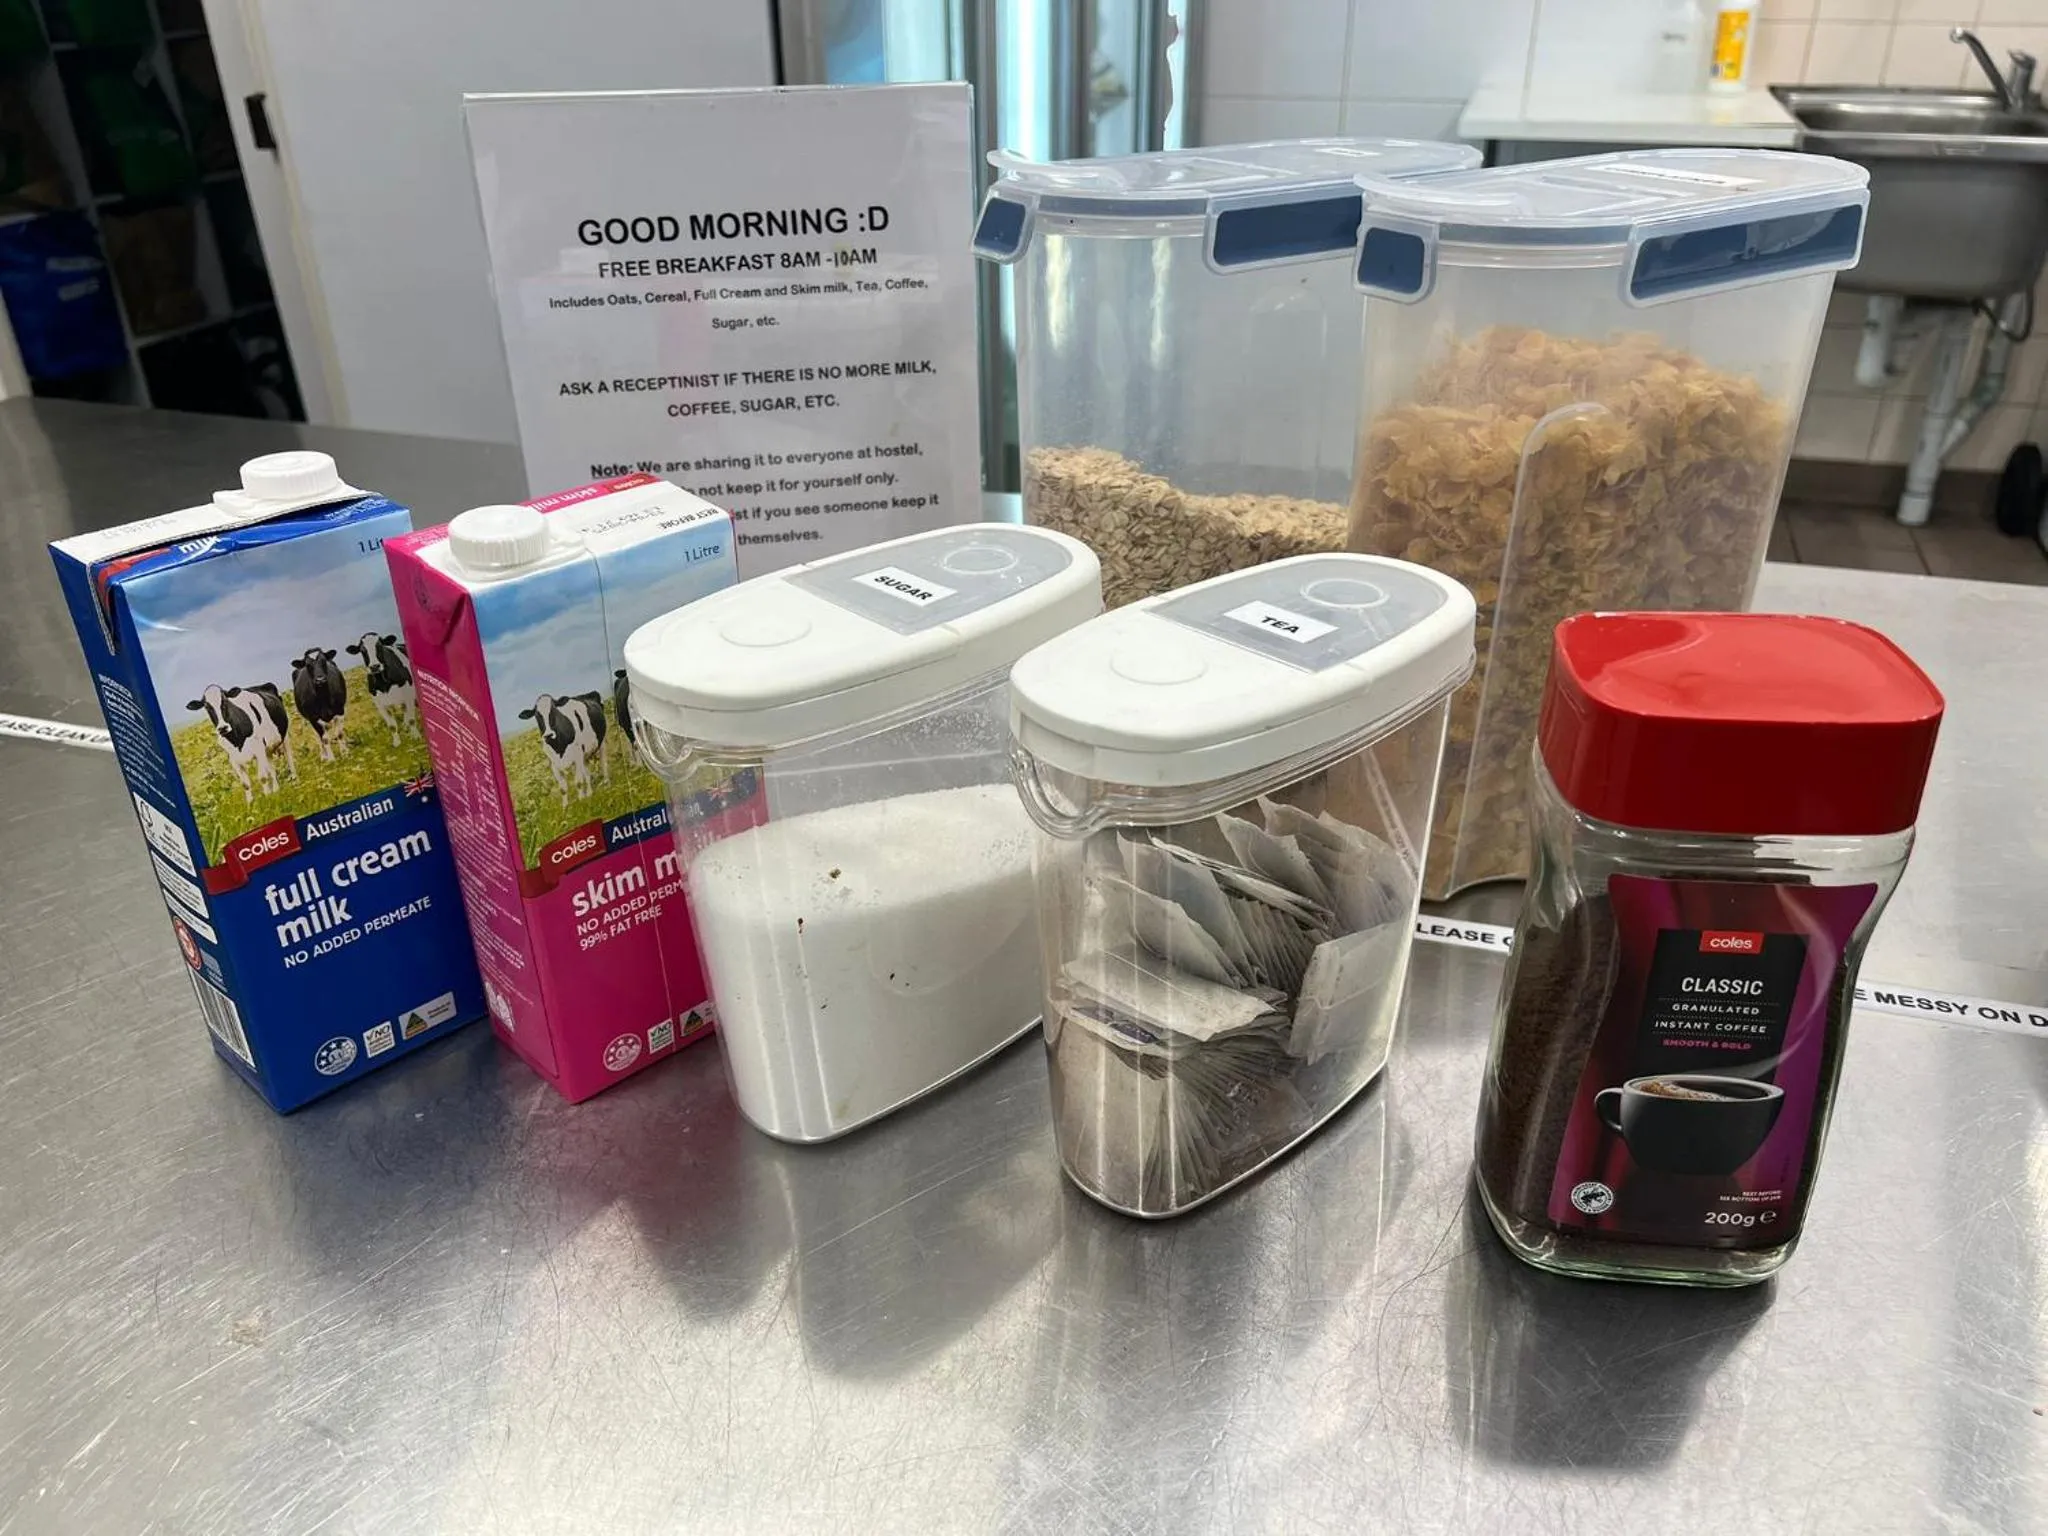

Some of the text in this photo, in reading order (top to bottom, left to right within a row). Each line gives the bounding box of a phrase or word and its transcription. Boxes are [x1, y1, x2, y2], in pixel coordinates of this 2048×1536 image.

[577, 205, 889, 246] GOOD MORNING :D
[598, 260, 651, 278] FREE
[656, 254, 775, 275] BREAKFAST
[780, 252, 821, 269] 8AM
[549, 278, 929, 309] Includes Oats, Cereal, Full Cream and Skim milk, Tea, Coffee,
[711, 315, 780, 331] Sugar, etc.
[559, 360, 937, 396] ASK A RECEPTINIST IF THERE IS NO MORE MILK,
[667, 394, 840, 417] COFFEE, SUGAR, ETC.
[590, 443, 924, 480] Note: We are sharing it to everyone at hostel,
[698, 483, 724, 496] not
[726, 481, 763, 498] keep
[765, 479, 776, 492] it
[779, 478, 800, 491] for
[803, 473, 863, 492] yourself
[865, 471, 899, 487] only.
[530, 497, 560, 512] mil
[751, 506, 761, 518] if
[764, 505, 791, 521] you
[794, 504, 820, 516] see
[823, 500, 889, 514] someone
[891, 496, 927, 510] keep
[929, 493, 940, 506] it
[358, 541, 366, 553] 1
[737, 529, 824, 546] themselves.
[684, 544, 720, 562] 1 Litre
[873, 575, 933, 600] SUGAR
[1261, 615, 1299, 634] TEA
[238, 831, 290, 862] coles
[306, 797, 395, 842] Australian
[551, 832, 597, 865] coles
[264, 867, 323, 917] full
[331, 829, 433, 888] cream
[571, 865, 646, 918] skim
[576, 877, 685, 937] NO ADDED PERM
[276, 894, 353, 948] milk
[283, 895, 433, 969] NO ADDED PERMEATE
[579, 905, 663, 952] 99% FAT FREE
[1710, 936, 1753, 950] coles
[1415, 922, 1496, 945] LEASE
[1873, 990, 1970, 1016] MESSY
[1978, 1006, 2022, 1025] ON
[1681, 976, 1764, 996] CLASSIC
[1672, 1003, 1760, 1015] GRANULATED
[1654, 1020, 1767, 1034] INSTANT COFFEE
[1662, 1039, 1710, 1049] SMOOTH
[1704, 1211, 1756, 1228] 200g
